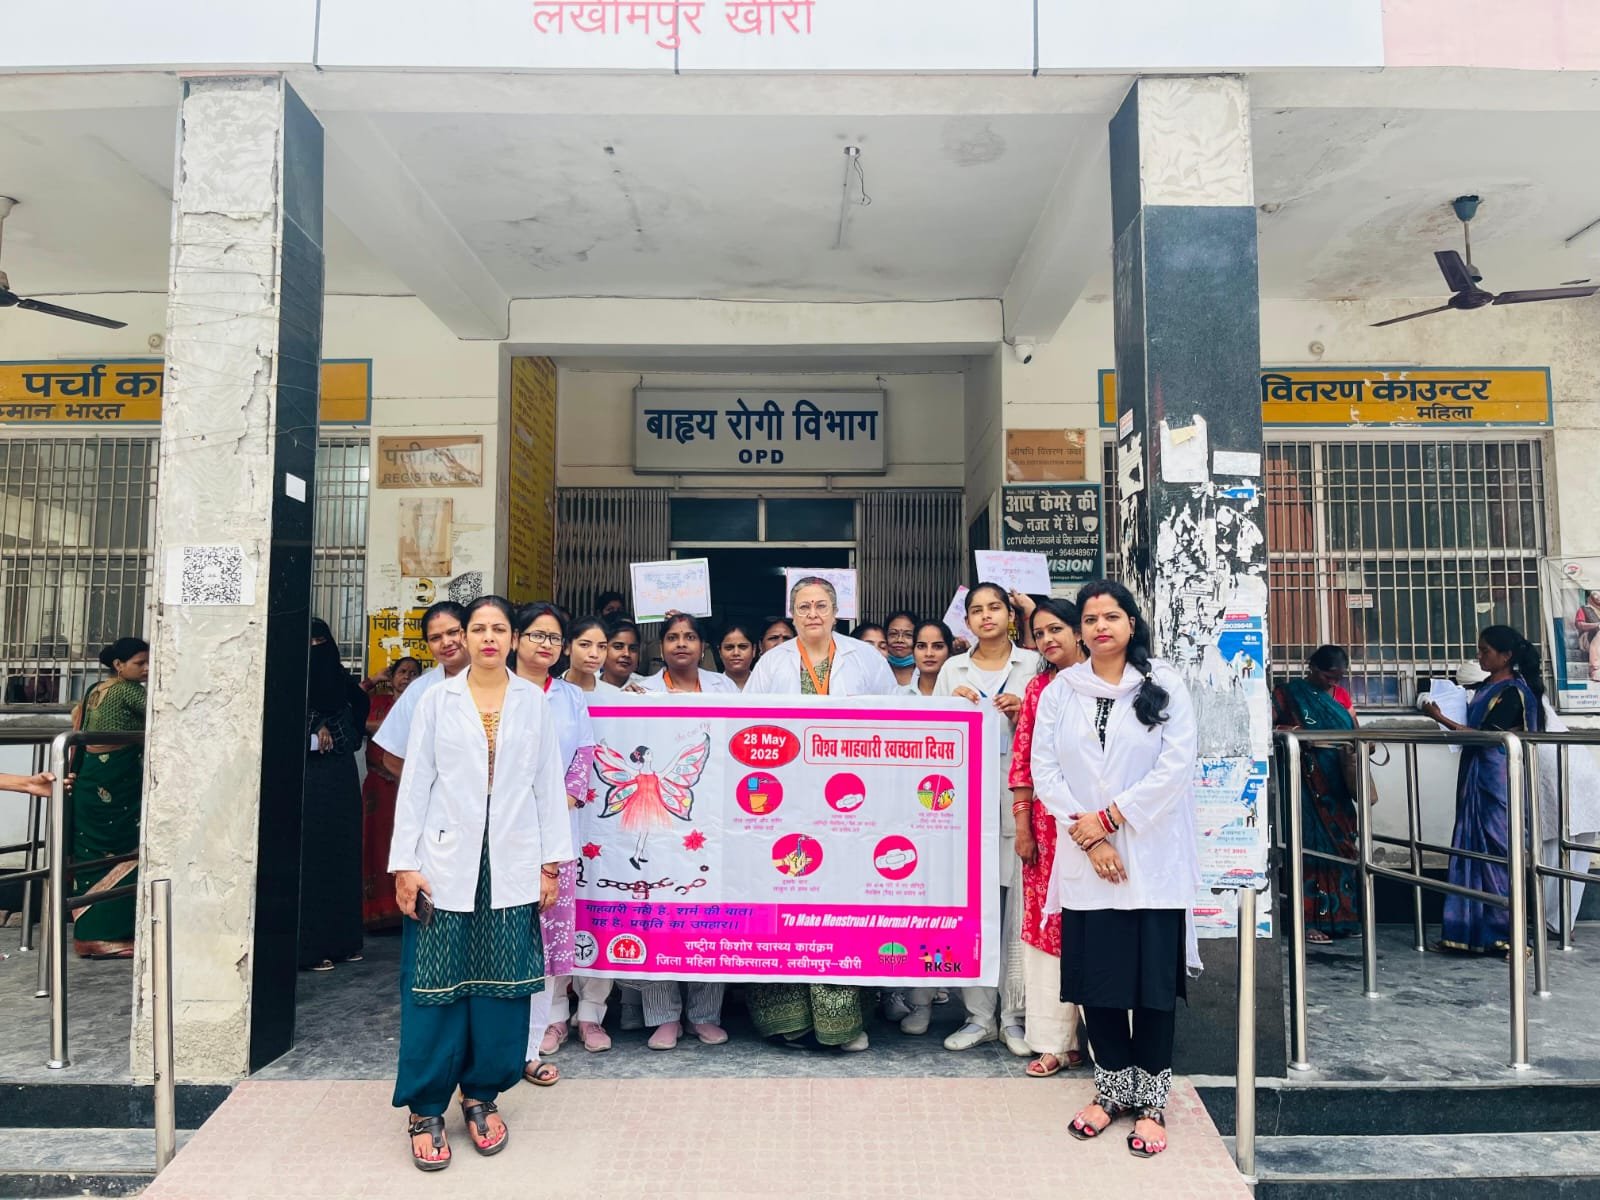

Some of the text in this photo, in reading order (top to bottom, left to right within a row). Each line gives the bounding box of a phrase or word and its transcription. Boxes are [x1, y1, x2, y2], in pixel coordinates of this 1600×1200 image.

[22, 364, 107, 398] पर्चा
[1261, 374, 1492, 402] वितरण काउन्टर
[65, 403, 126, 419] भारत
[1416, 402, 1474, 420] महिला
[725, 398, 785, 441] रोगी
[792, 399, 879, 441] विभाग
[738, 448, 785, 465] OPD
[1005, 489, 1098, 513] आप कैमरे की
[1025, 518, 1050, 532] नजर
[1053, 514, 1063, 531] में
[743, 733, 787, 748] 28 May
[812, 734, 955, 760] विश्व माहवारी स्वच्छता दिवस
[750, 748, 779, 760] 2025
[586, 903, 627, 914] माहवारी
[704, 905, 720, 916] की
[592, 918, 607, 928] यह
[630, 918, 663, 931] प्रकृति
[669, 919, 685, 929] का
[796, 914, 821, 928] Make
[821, 914, 868, 928] Menstrual
[867, 915, 876, 928] A
[876, 915, 909, 929] Normal
[910, 915, 930, 929] Part
[930, 916, 940, 929] of
[684, 938, 834, 953] राष्ट्रीय किशोर स्वास्थ्य कार्यक्रम
[656, 953, 682, 966] जिला
[686, 953, 716, 968] महिला
[924, 962, 961, 973] RKSK
